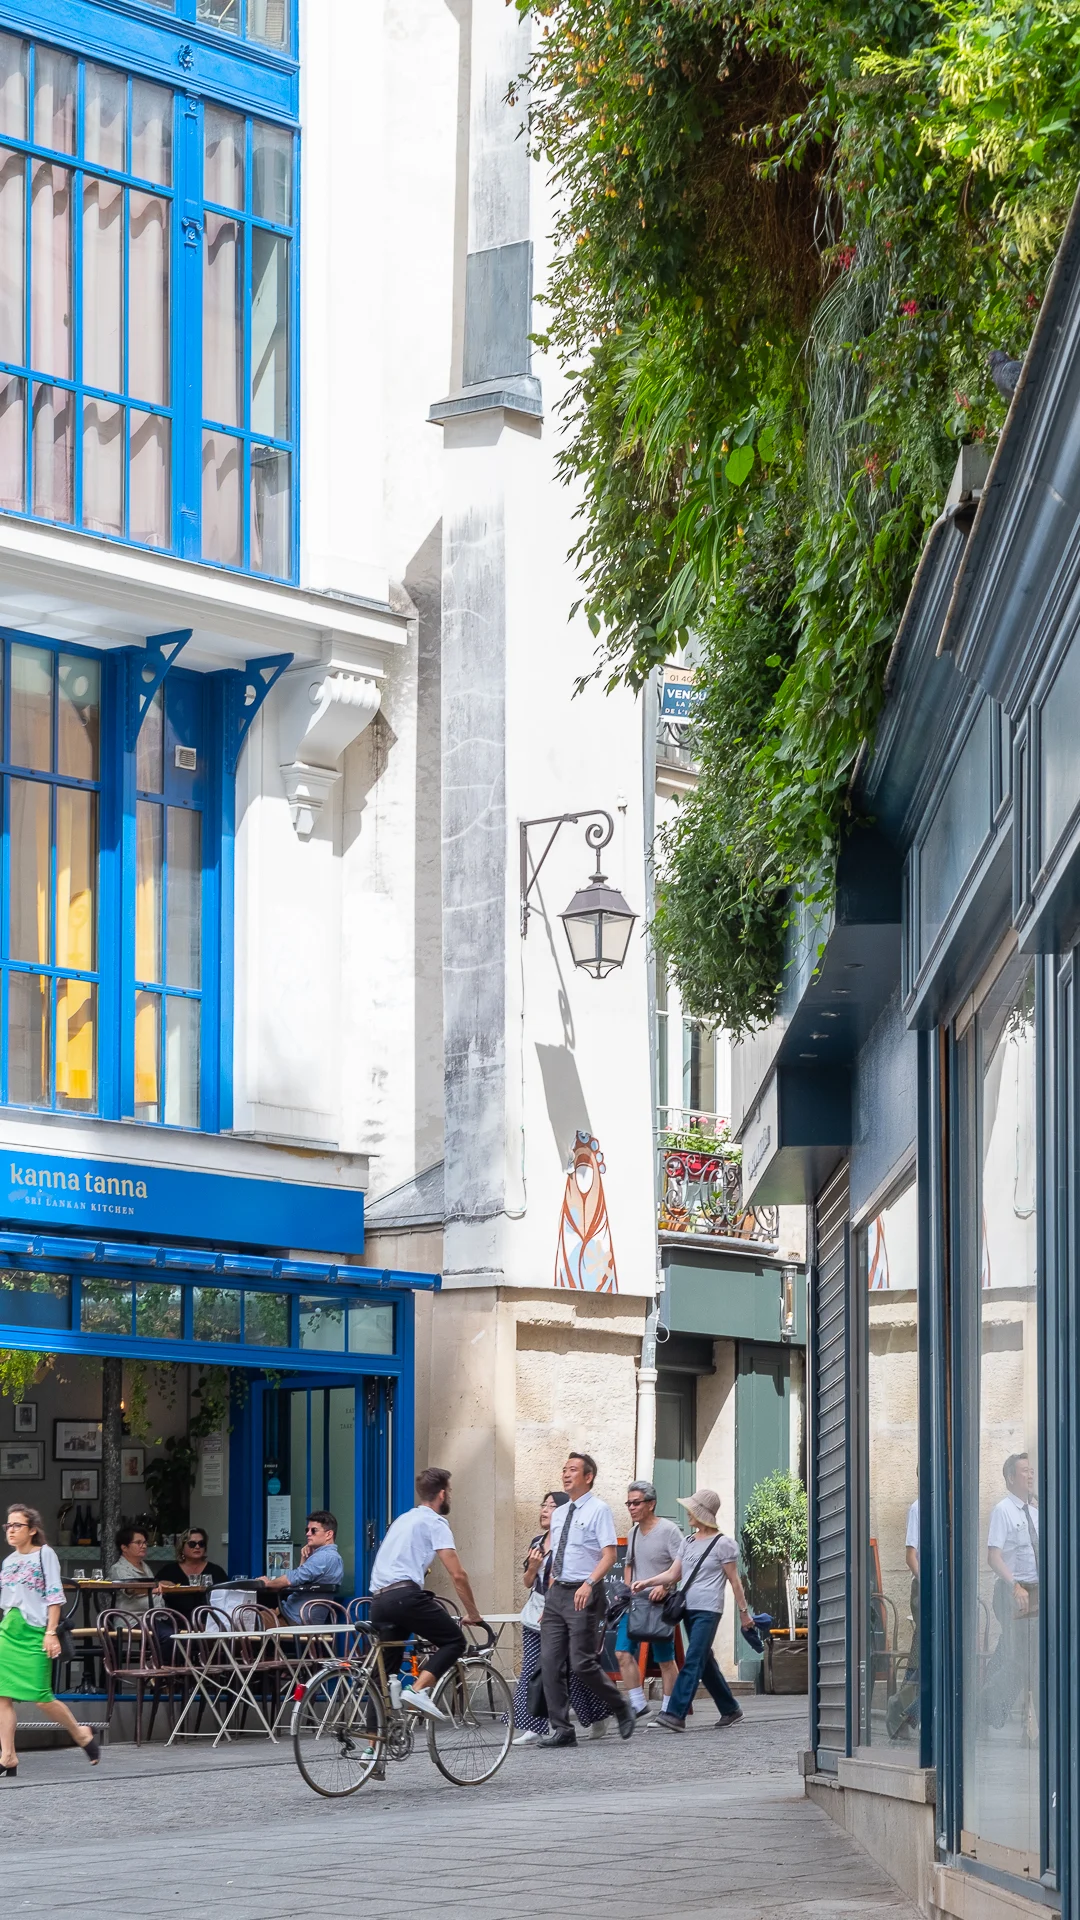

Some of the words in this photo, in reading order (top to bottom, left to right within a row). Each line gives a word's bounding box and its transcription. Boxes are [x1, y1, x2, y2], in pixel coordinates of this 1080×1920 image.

[670, 674, 679, 682] 01
[667, 688, 707, 701] VENDU
[10, 1163, 80, 1191] kanna
[84, 1172, 148, 1199] tanna
[25, 1195, 42, 1206] SRI
[46, 1198, 86, 1210] LANKAN
[91, 1203, 135, 1215] KITCHEN
